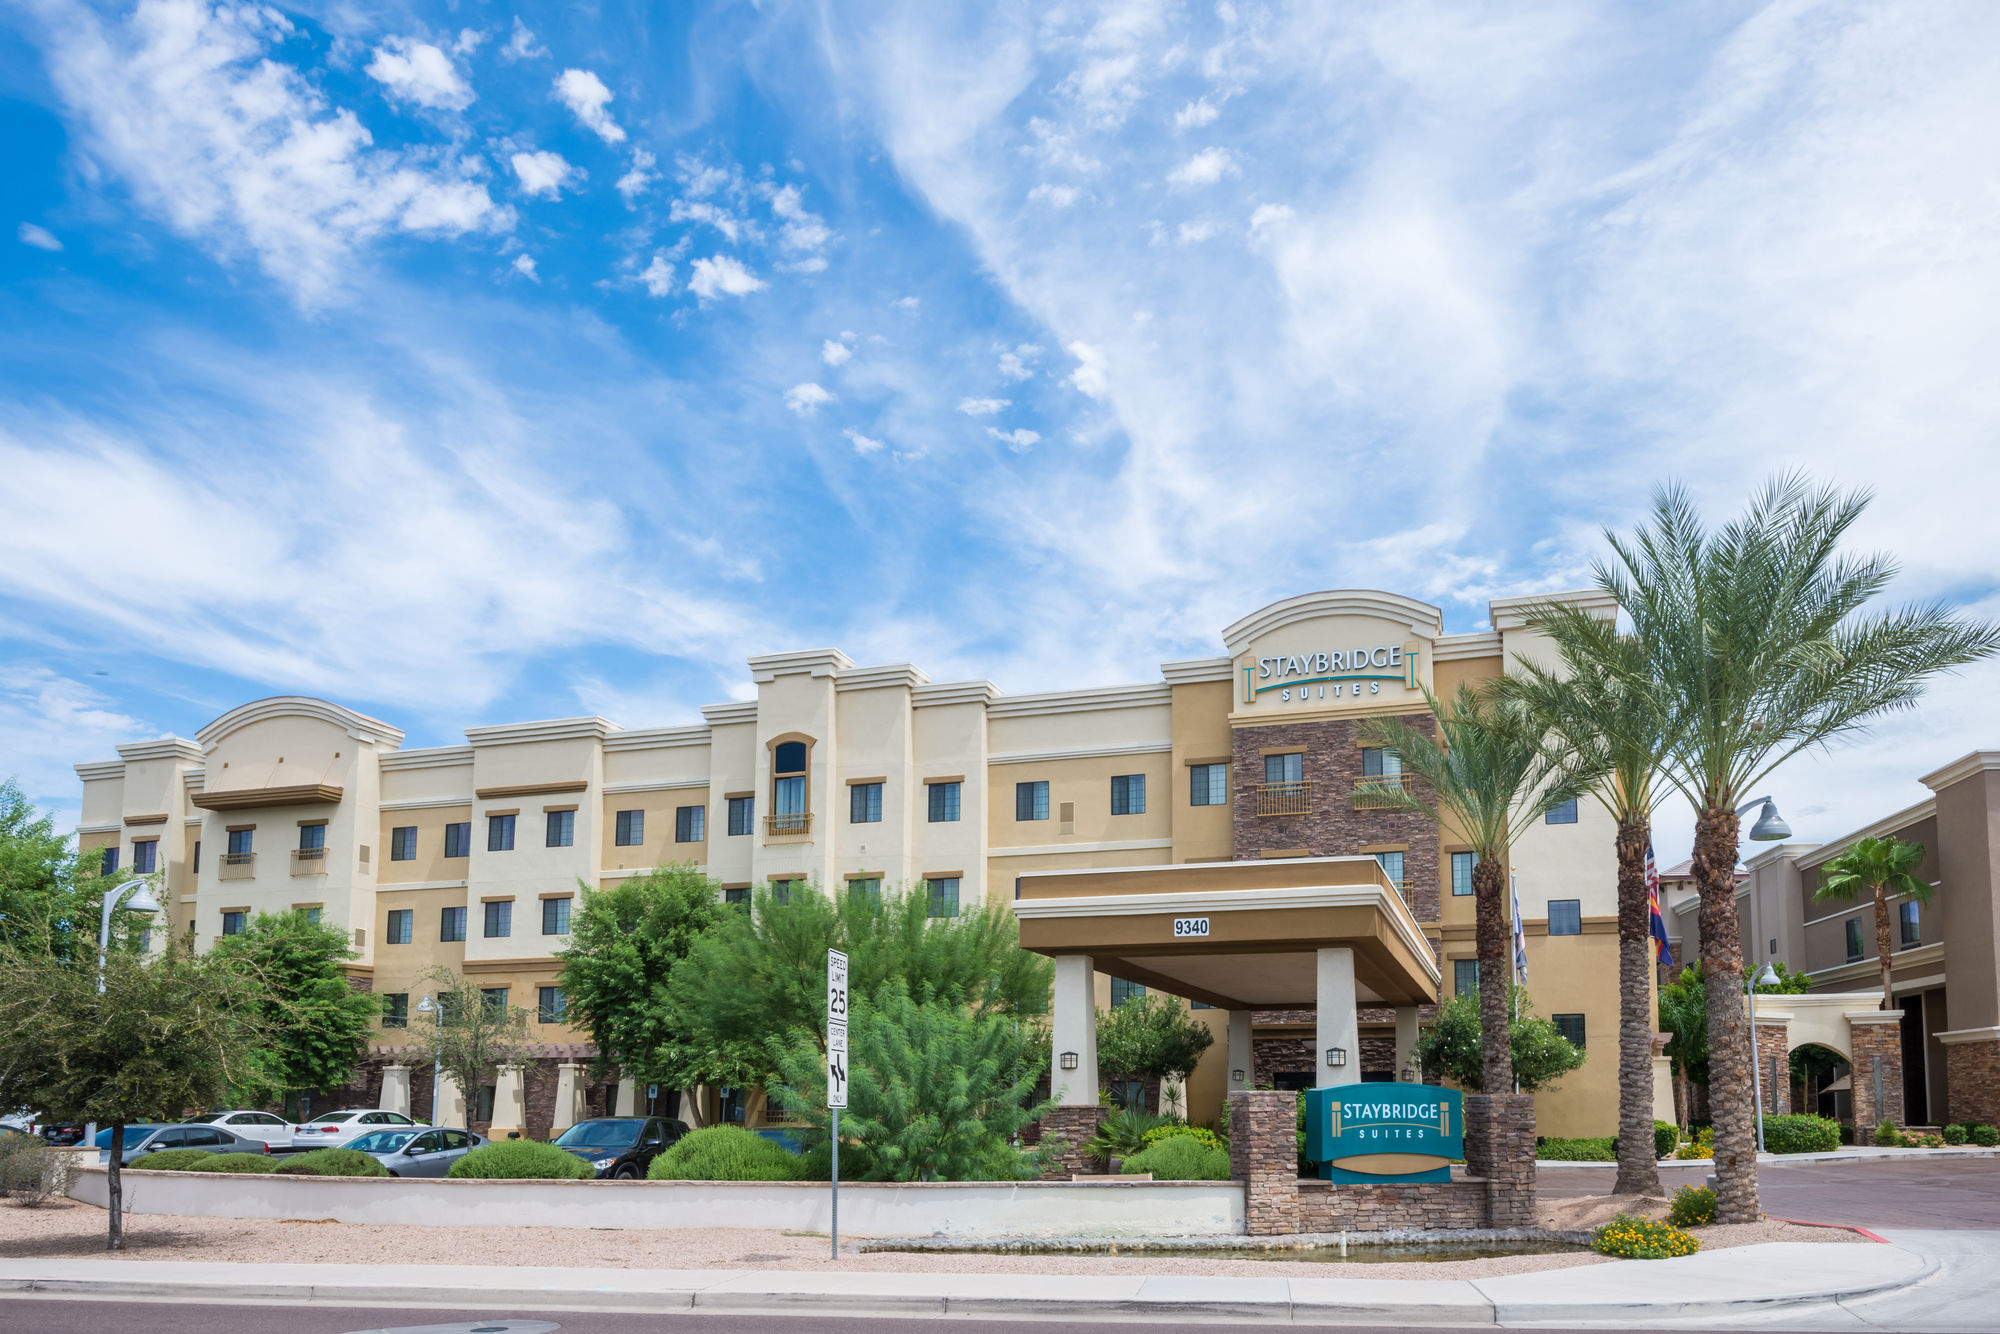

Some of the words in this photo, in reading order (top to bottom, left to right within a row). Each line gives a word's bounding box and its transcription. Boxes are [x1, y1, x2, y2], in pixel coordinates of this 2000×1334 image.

[1258, 645, 1402, 679] STAYBRIDGE
[1281, 681, 1379, 701] SUITES
[1175, 920, 1208, 935] 9340
[830, 956, 846, 970] SPEED
[831, 971, 845, 984] LIMIT
[830, 988, 846, 1015] 25
[830, 1027, 845, 1037] CENTER
[1343, 1103, 1438, 1119] STAYBRIDGE
[1359, 1129, 1424, 1139] SUITES
